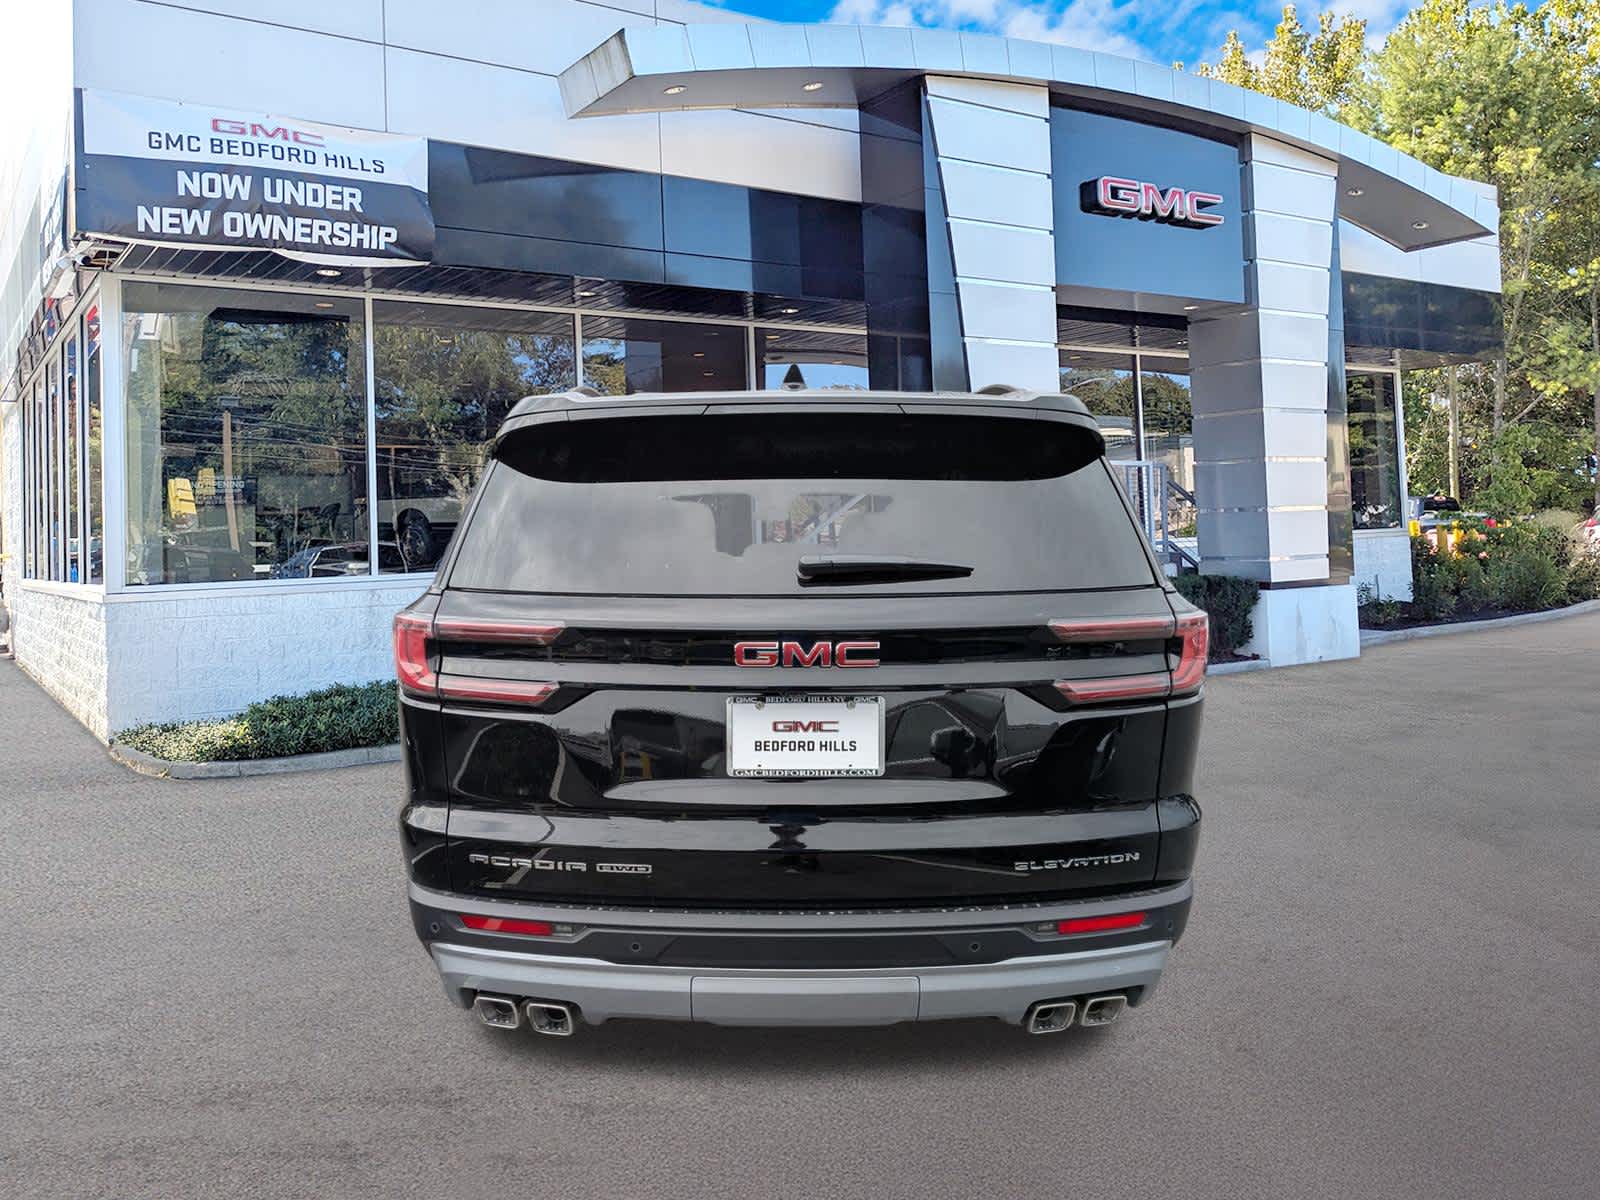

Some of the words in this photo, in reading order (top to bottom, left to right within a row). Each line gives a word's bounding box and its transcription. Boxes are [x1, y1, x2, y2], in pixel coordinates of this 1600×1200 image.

[211, 118, 326, 147] GMC
[148, 131, 201, 152] GMC
[210, 137, 316, 165] BEDFORD
[325, 153, 385, 174] HILLS
[177, 170, 252, 200] NOW
[263, 177, 363, 213] UNDER
[1096, 175, 1224, 225] GMC
[137, 205, 211, 236] NEW
[223, 211, 398, 250] OWNERSHIP
[734, 641, 880, 668] GMC
[766, 696, 807, 704] BEDFORD
[808, 696, 832, 704] HILLS
[772, 721, 839, 732] GMC
[754, 740, 815, 752] BEDFORD
[819, 740, 857, 752] HILLS
[735, 768, 877, 777] GMCBEDFORDHILLS.COM
[469, 853, 587, 872] ACADIA
[597, 863, 652, 873] AWD
[1014, 852, 1140, 872] ELEVATION
